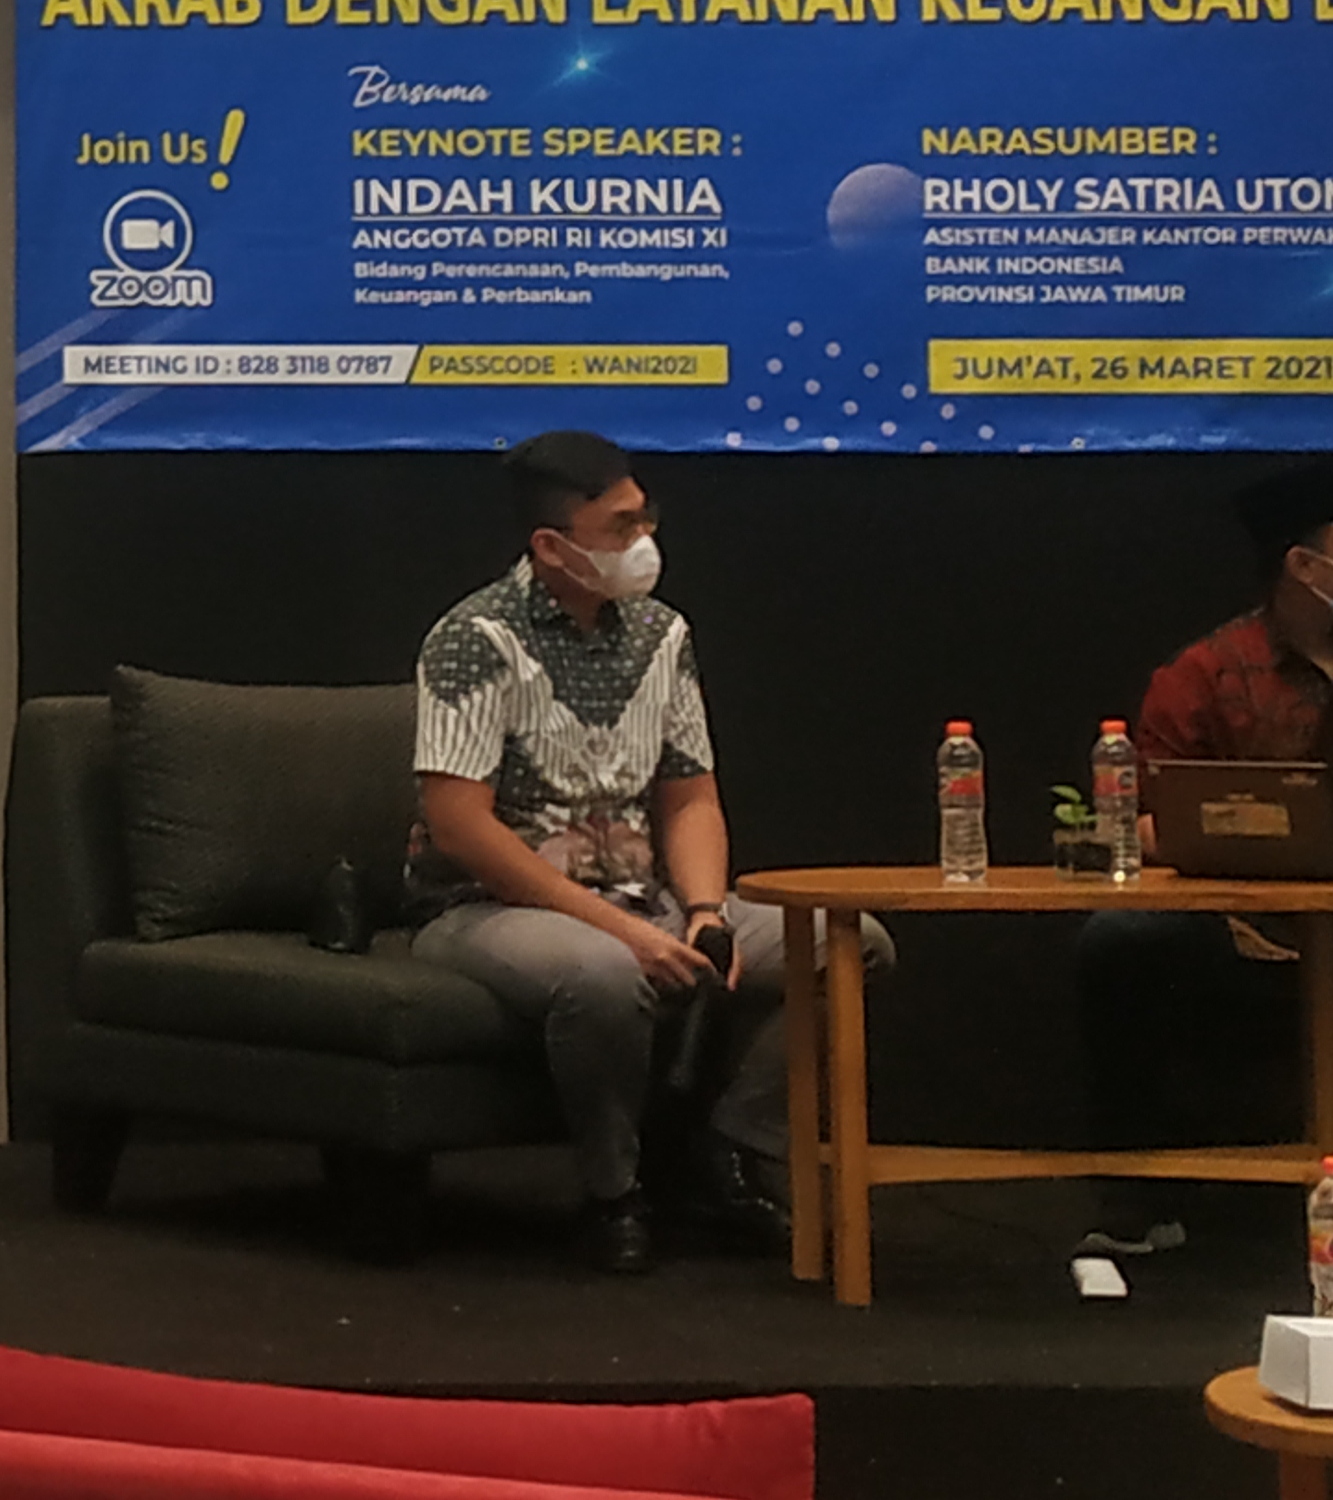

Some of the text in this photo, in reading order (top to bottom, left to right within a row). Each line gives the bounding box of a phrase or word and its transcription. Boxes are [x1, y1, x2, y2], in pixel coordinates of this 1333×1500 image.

[348, 65, 489, 108] Bersama
[76, 132, 151, 165] Join
[352, 128, 532, 157] KEYNOTE
[543, 127, 722, 157] SPEAKER
[922, 126, 1197, 156] NARASUMBER
[353, 178, 722, 214] INDAH KURNIA
[923, 178, 1064, 211] RHOLY
[1074, 177, 1225, 211] SATRIA
[352, 226, 727, 249] ANGGOTA DPRI RI KOMISI XI
[923, 226, 1333, 246] ASISTEN MANAJER KANTOR PERWA
[353, 260, 730, 281] Bidang Perencanaan, Pembangunan,
[925, 256, 1124, 275] BANK INDONESIA
[89, 270, 215, 308] zoom
[354, 288, 458, 307] Keuangan
[481, 286, 592, 304] Perbankan
[925, 284, 1186, 304] PROVINSI JAWA TIMUR
[83, 354, 189, 375] MEETING
[194, 355, 220, 376] ID
[237, 354, 280, 376] 828
[285, 354, 331, 376] 3118
[336, 354, 393, 376] 0787
[428, 354, 556, 376] PASSCODE
[1090, 356, 1129, 381] 26
[1138, 355, 1256, 380] MARET
[1264, 355, 1333, 381] 2021
